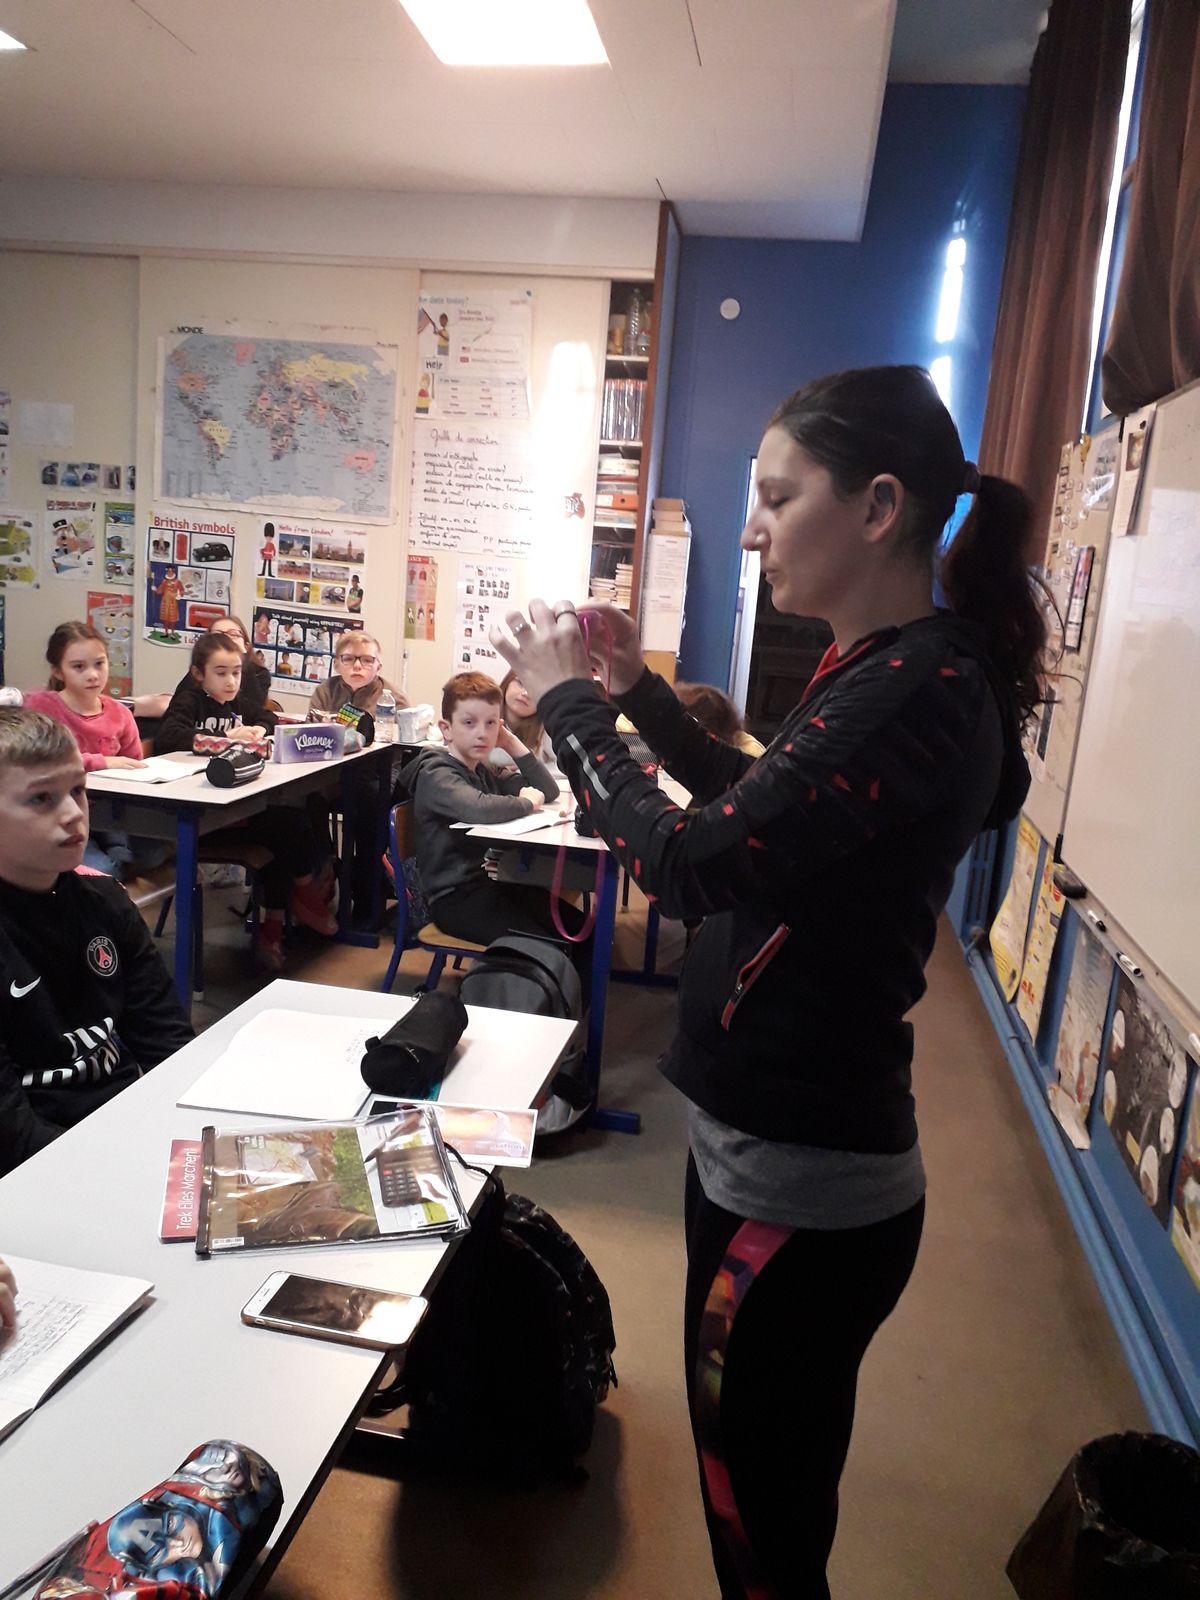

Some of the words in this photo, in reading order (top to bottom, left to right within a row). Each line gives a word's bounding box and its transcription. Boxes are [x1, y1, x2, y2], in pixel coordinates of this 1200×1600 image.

[446, 297, 470, 305] today?
[177, 326, 204, 334] MONDE
[154, 516, 190, 530] British
[192, 522, 236, 534] symbols
[278, 524, 292, 532] Hello
[294, 525, 310, 534] from
[311, 528, 334, 536] London!
[294, 733, 334, 751] Kleenex
[89, 938, 109, 952] PARIS
[178, 1190, 194, 1210] Elles
[176, 1211, 193, 1230] Trek
